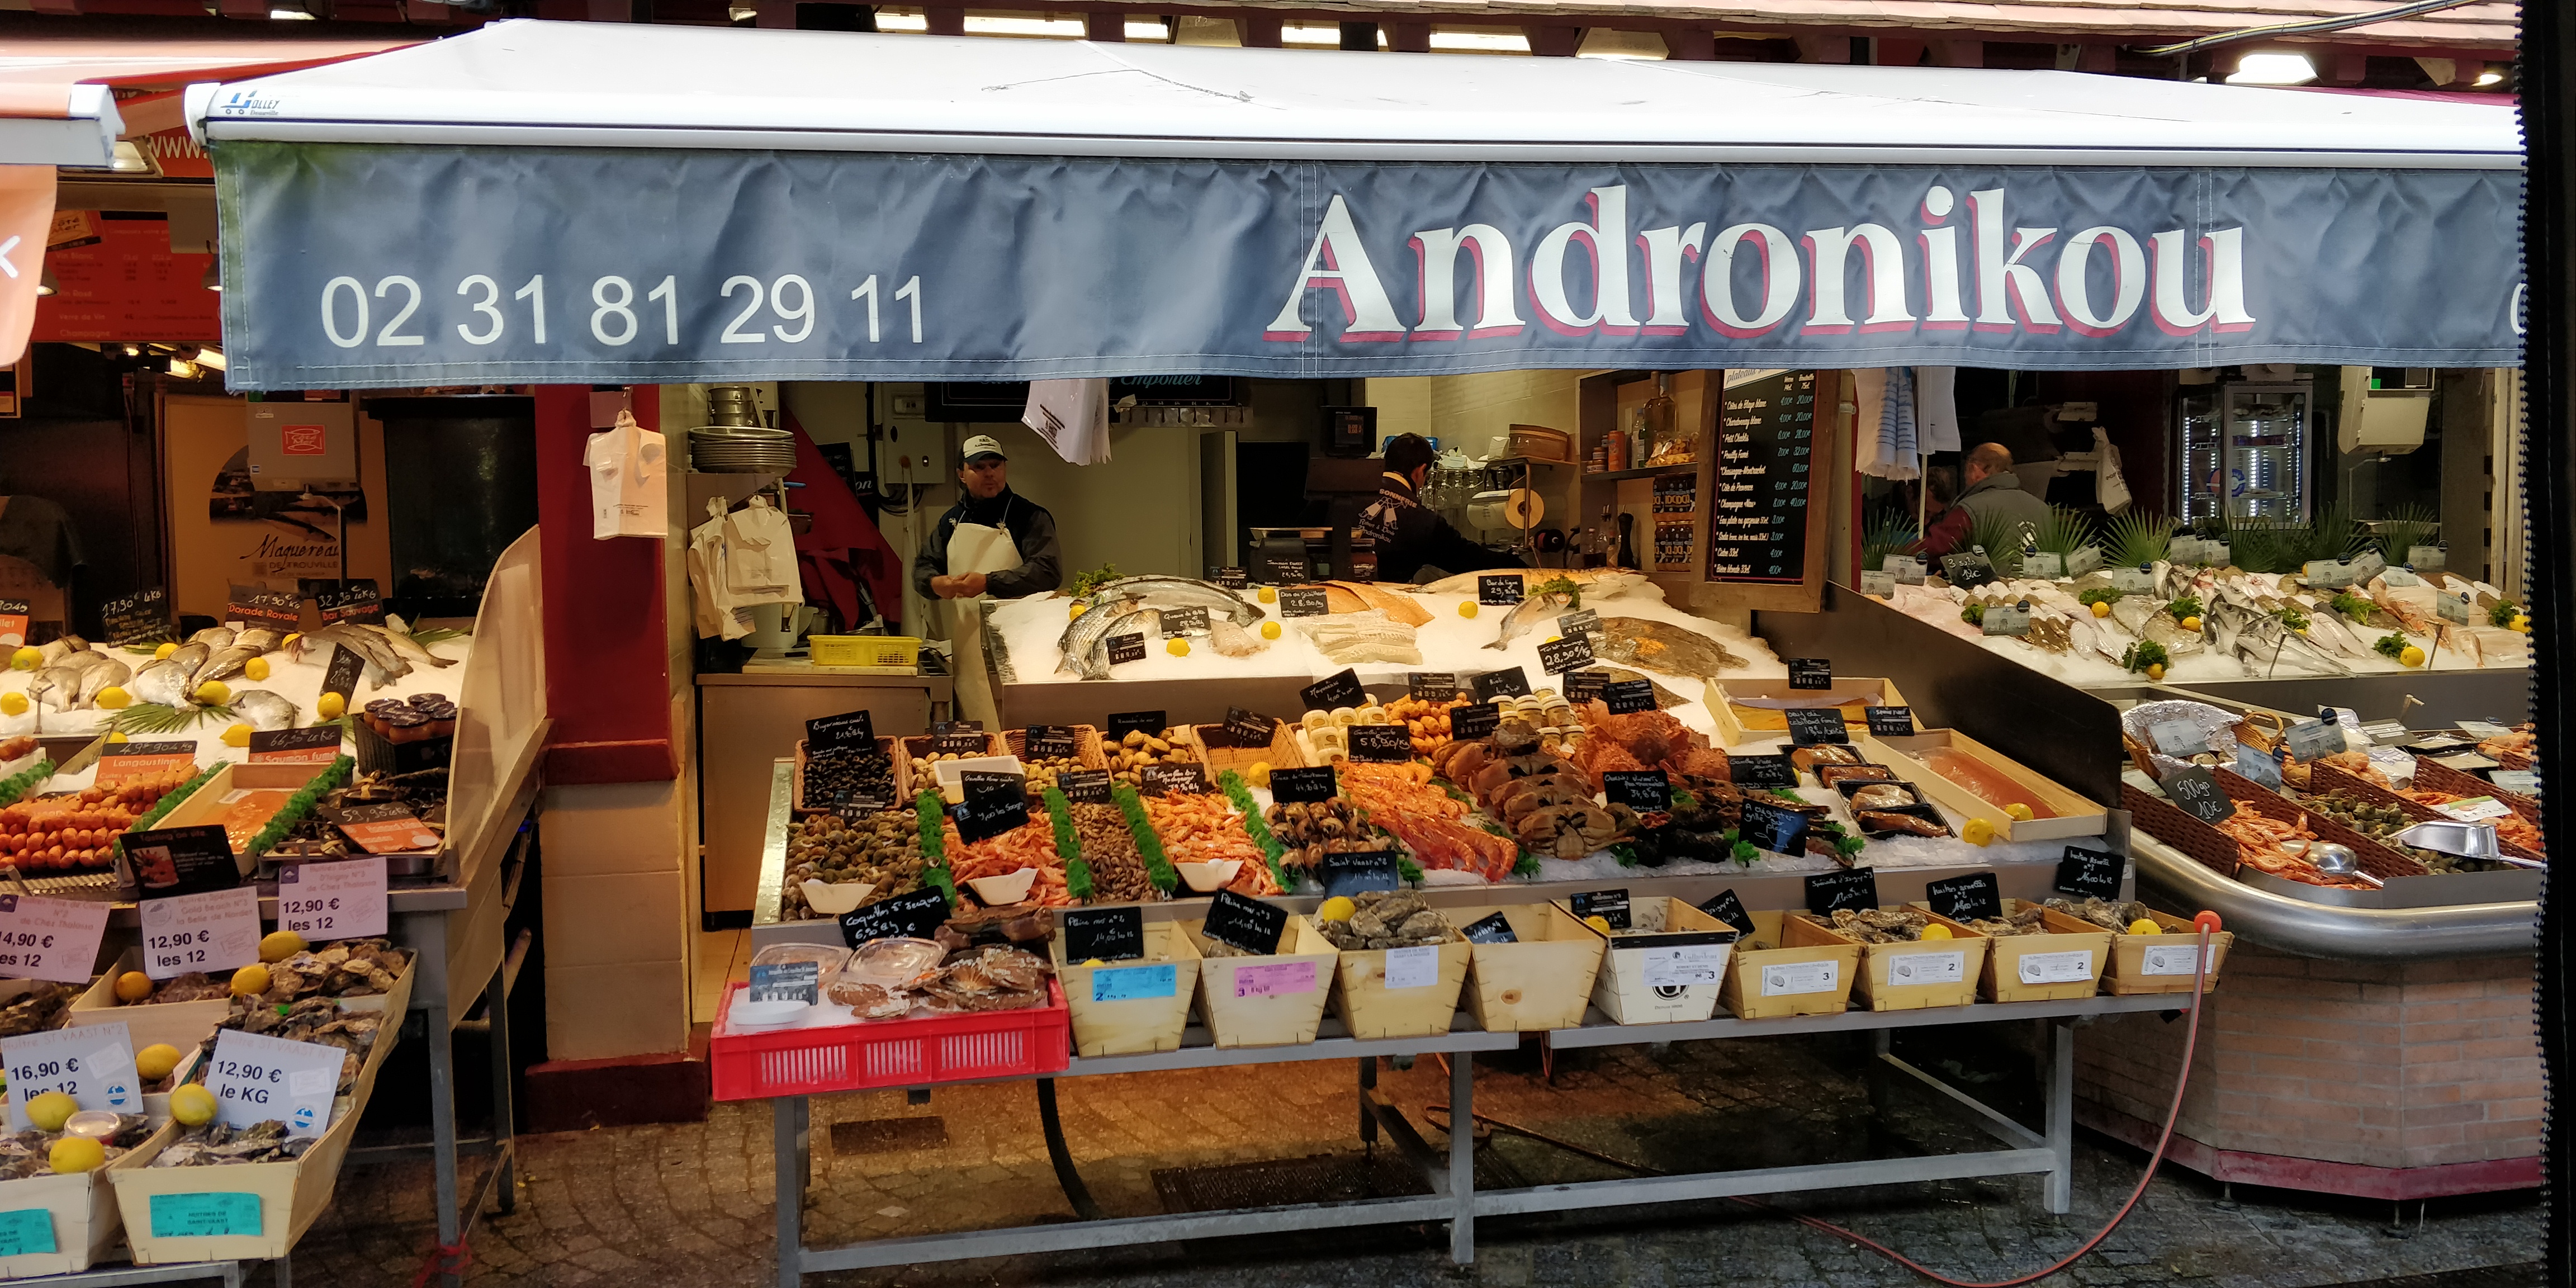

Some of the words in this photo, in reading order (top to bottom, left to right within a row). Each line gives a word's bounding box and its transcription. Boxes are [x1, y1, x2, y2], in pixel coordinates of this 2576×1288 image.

[1265, 184, 2257, 342] Andronikou
[320, 274, 425, 348] 02
[456, 274, 547, 345] 31
[590, 274, 679, 345] 81
[721, 274, 816, 344] 29
[851, 274, 923, 343] 11
[228, 604, 263, 616] Dorade
[267, 608, 299, 622] Royale
[322, 610, 339, 621] Bar
[340, 604, 380, 617] Sauvage
[283, 898, 323, 915] 12,90
[328, 897, 340, 911] €
[288, 919, 311, 931] les
[316, 916, 334, 929] 12
[41, 935, 54, 949] €
[149, 932, 192, 950] 12,90
[197, 930, 210, 943] €
[24, 954, 42, 968] 12
[157, 955, 181, 968] les
[187, 949, 206, 963] 12
[2077, 962, 2084, 970] 2
[1708, 971, 1715, 979] 3
[1948, 963, 1955, 972] 2
[1822, 972, 1830, 981] 3
[11, 1060, 60, 1082] 16,90
[65, 1057, 80, 1073] €
[217, 1060, 263, 1081] 12,90
[268, 1068, 282, 1083] €
[57, 1080, 78, 1095] 12
[219, 1083, 236, 1099] le
[241, 1086, 269, 1105] KG
